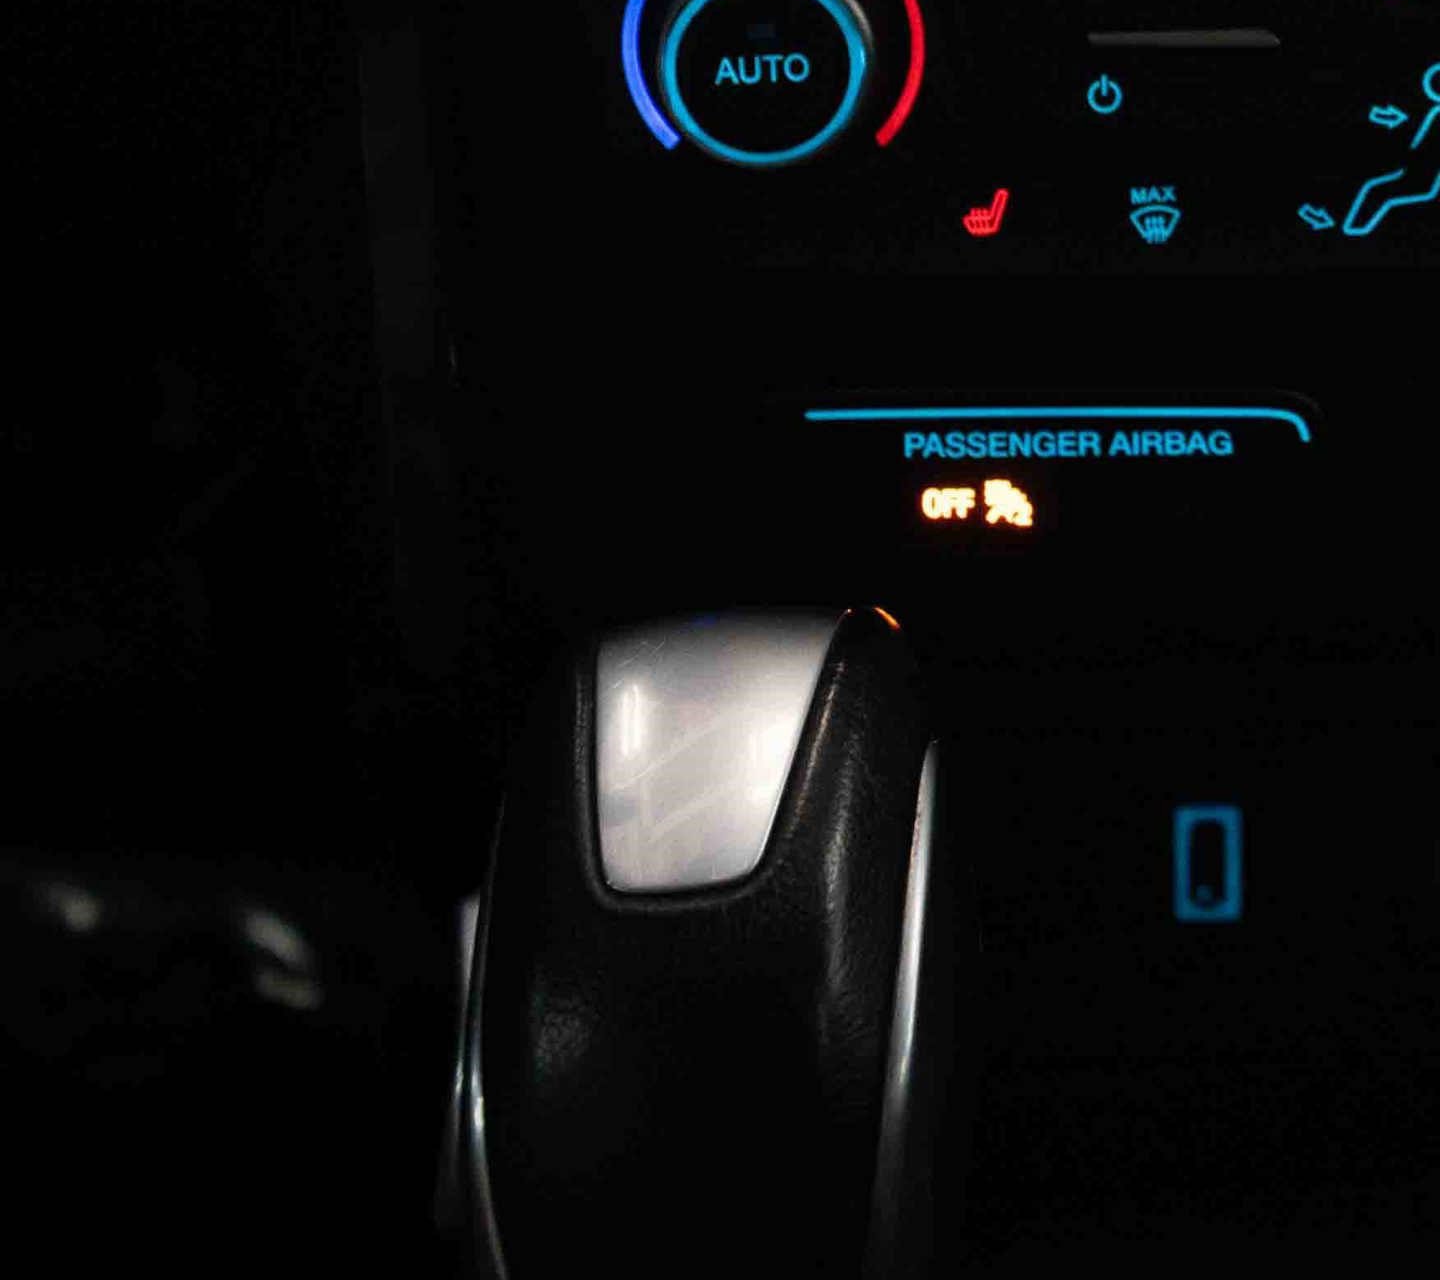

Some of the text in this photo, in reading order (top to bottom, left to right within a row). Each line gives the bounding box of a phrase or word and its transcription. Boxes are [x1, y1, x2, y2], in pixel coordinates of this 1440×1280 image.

[714, 53, 810, 85] AUTO
[1130, 186, 1176, 204] MAX
[903, 429, 1234, 459] PASSENGER AIRBAG
[921, 487, 977, 520] OFF
